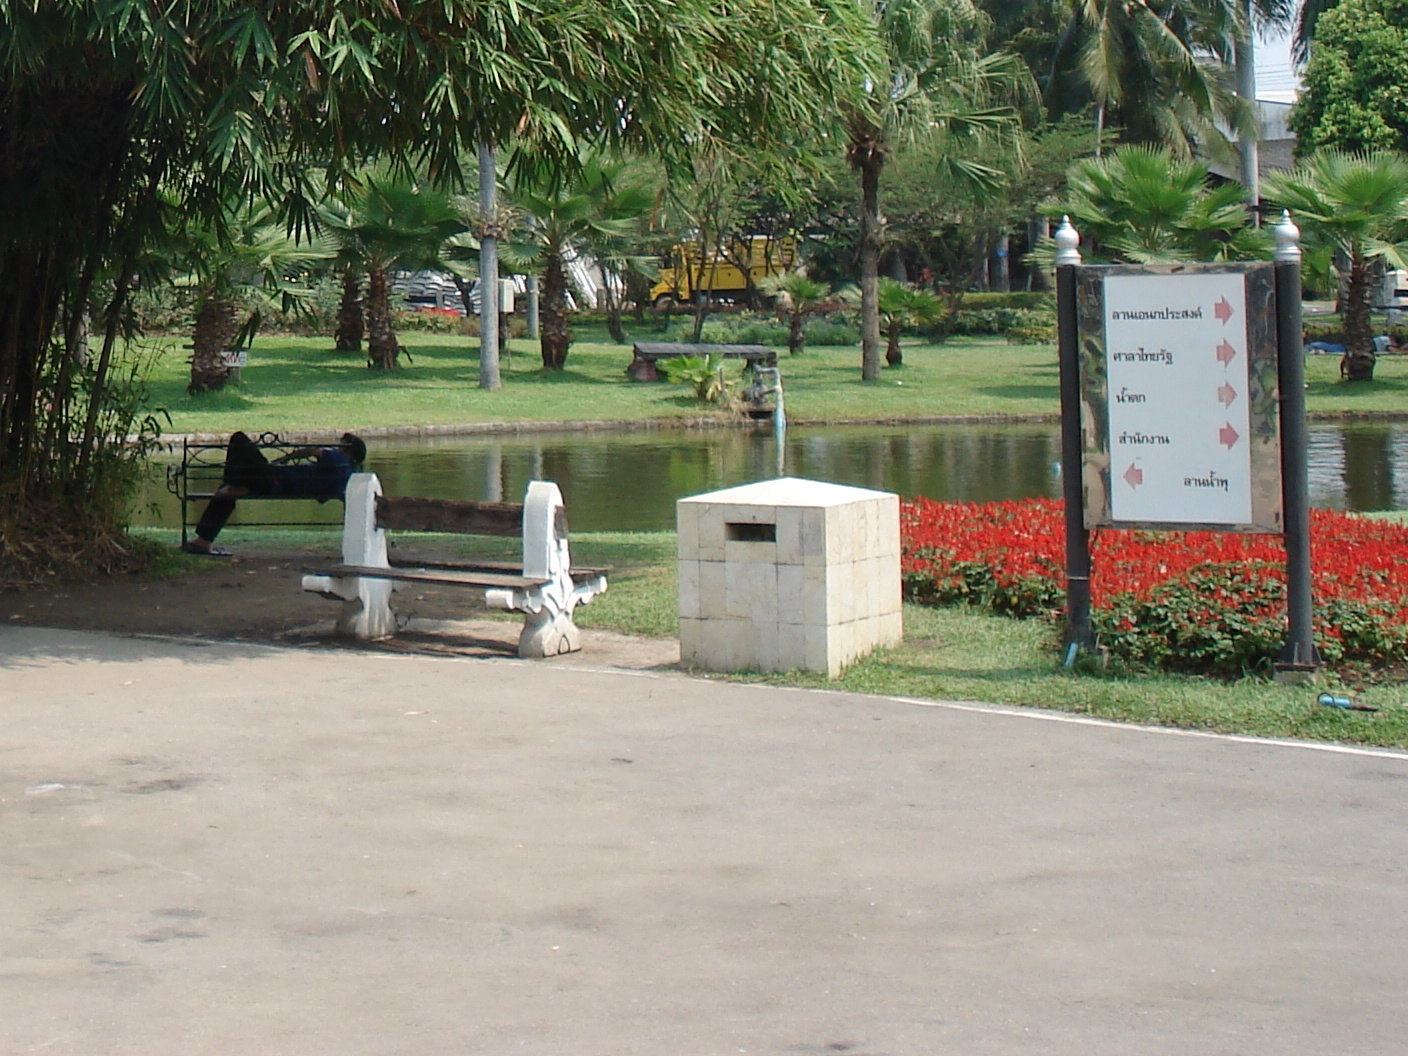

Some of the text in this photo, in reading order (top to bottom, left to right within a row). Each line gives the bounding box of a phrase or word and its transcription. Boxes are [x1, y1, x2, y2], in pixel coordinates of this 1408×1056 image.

[1112, 307, 1202, 320] ลานเอนกประสงค์
[1113, 347, 1173, 365] ศาลาไทยรัฐ
[1116, 387, 1146, 404] น้ำตก
[1119, 431, 1170, 444] สำนักงาน
[1184, 470, 1229, 492] ลานน้ำพุ
